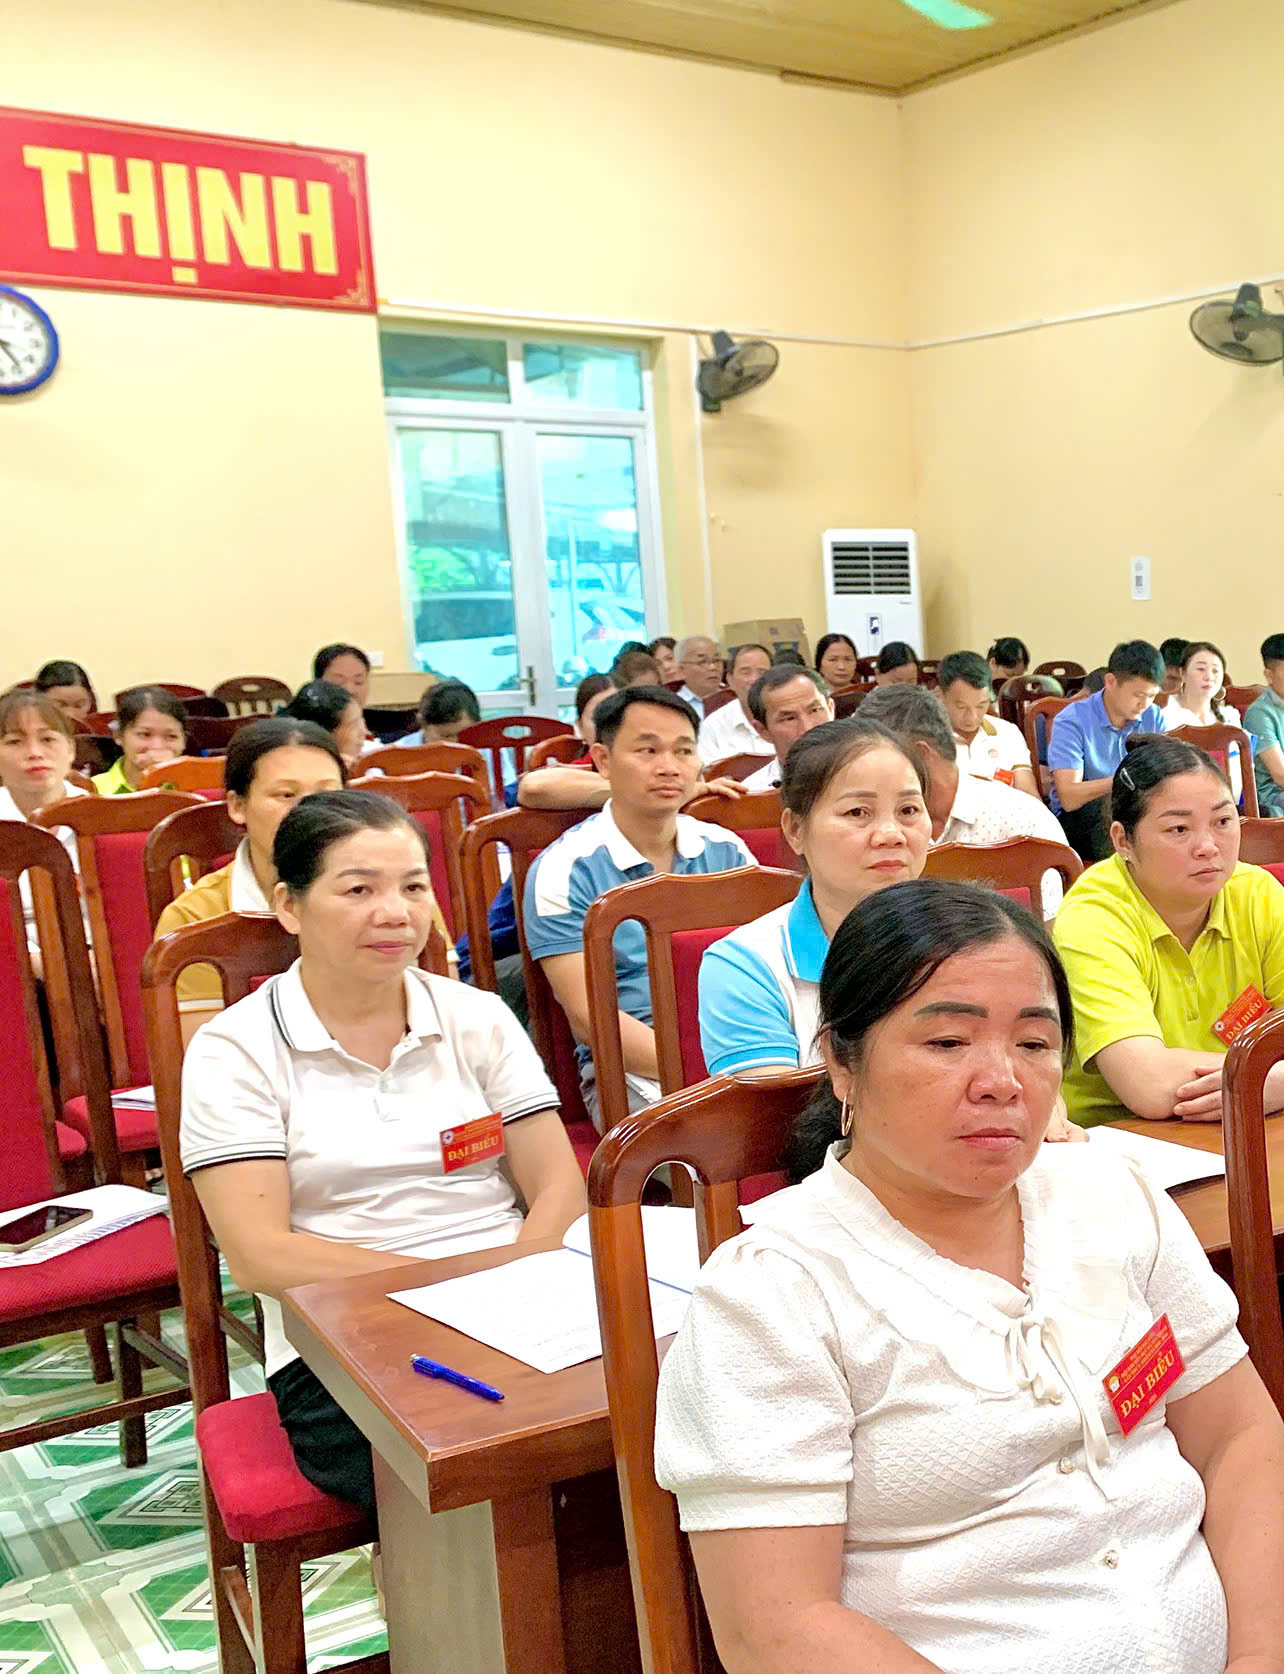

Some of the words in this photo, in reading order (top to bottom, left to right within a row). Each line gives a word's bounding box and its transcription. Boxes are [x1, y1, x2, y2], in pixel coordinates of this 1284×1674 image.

[22, 144, 339, 284] THỊNH
[1120, 1385, 1145, 1417] ĐẠI
[1145, 1350, 1175, 1391] BIỂU
